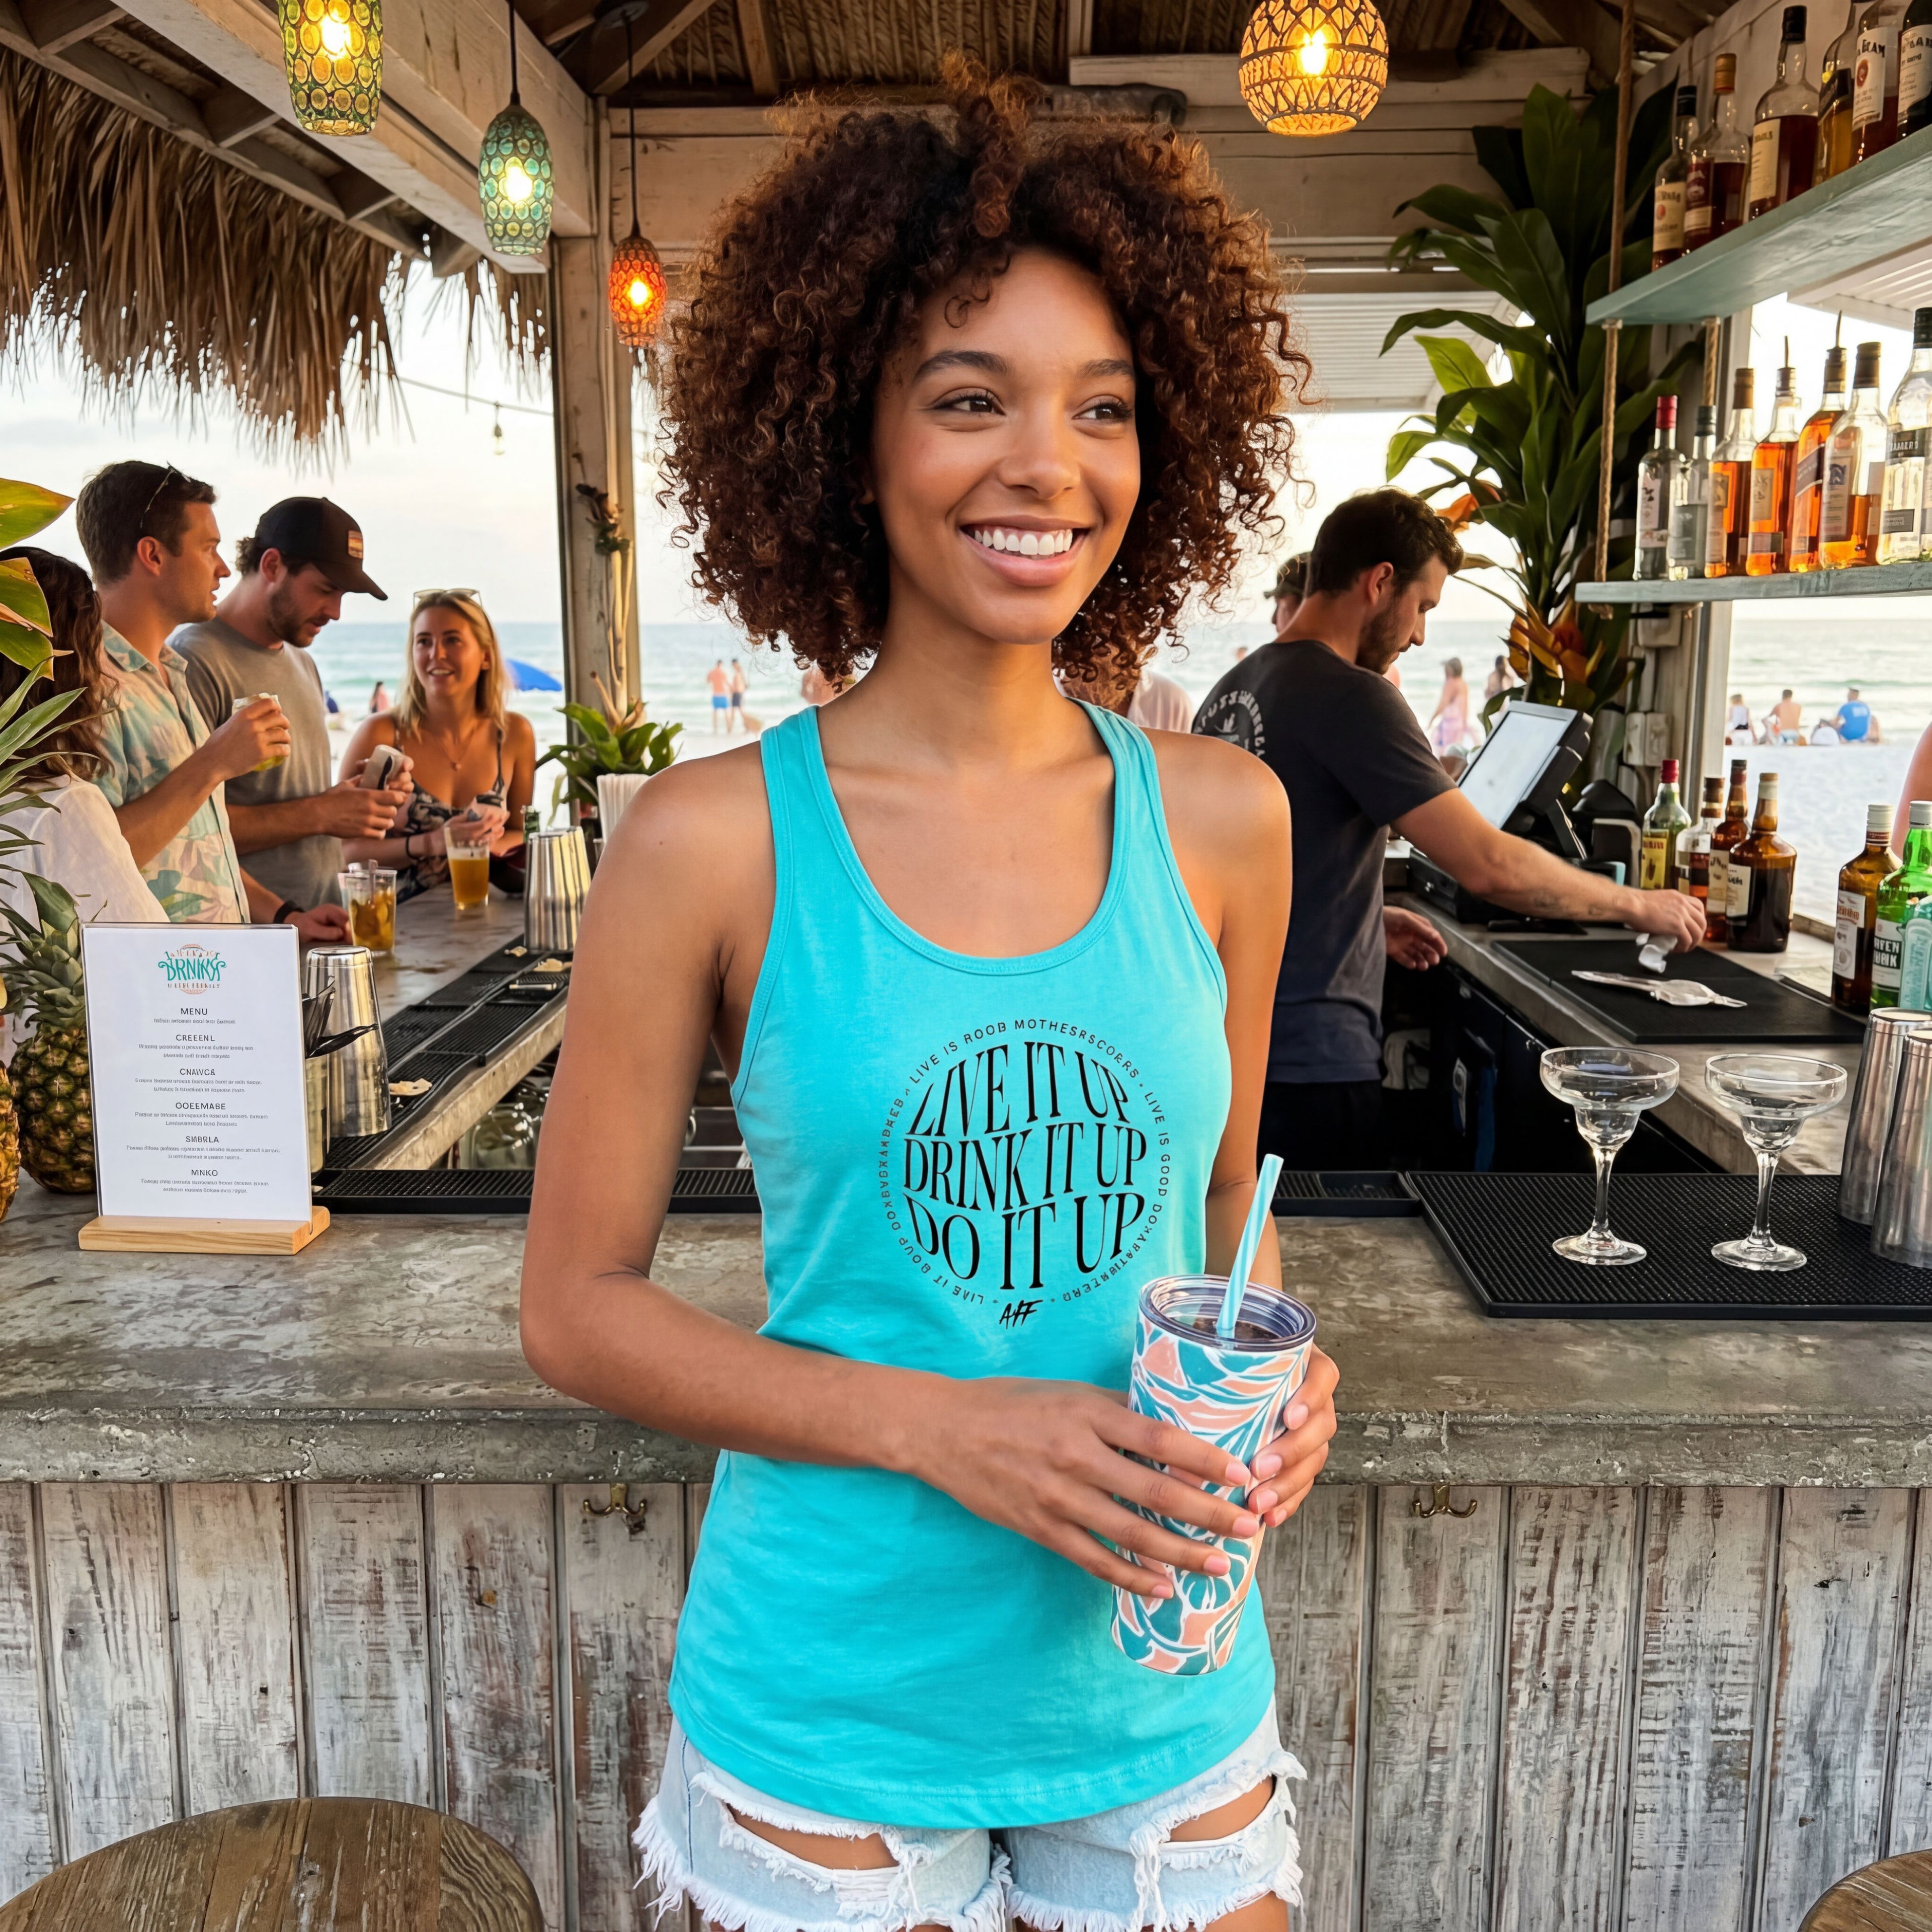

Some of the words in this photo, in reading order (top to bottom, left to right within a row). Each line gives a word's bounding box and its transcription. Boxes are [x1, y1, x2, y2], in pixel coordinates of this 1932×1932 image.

[905, 1044, 1010, 1137] LIVE
[1024, 1041, 1066, 1123] IT
[1074, 1051, 1131, 1124] UP
[909, 1054, 940, 1084] LIVE
[943, 1041, 958, 1056] IS
[1144, 1091, 1166, 1124] LIVE
[1158, 1132, 1170, 1146] IS
[903, 1129, 1033, 1212] DRINK
[1042, 1122, 1084, 1200] IT
[1095, 1122, 1147, 1188] UP
[902, 1192, 980, 1280] DO
[1000, 1201, 1056, 1290] IT
[1074, 1192, 1145, 1274] UP
